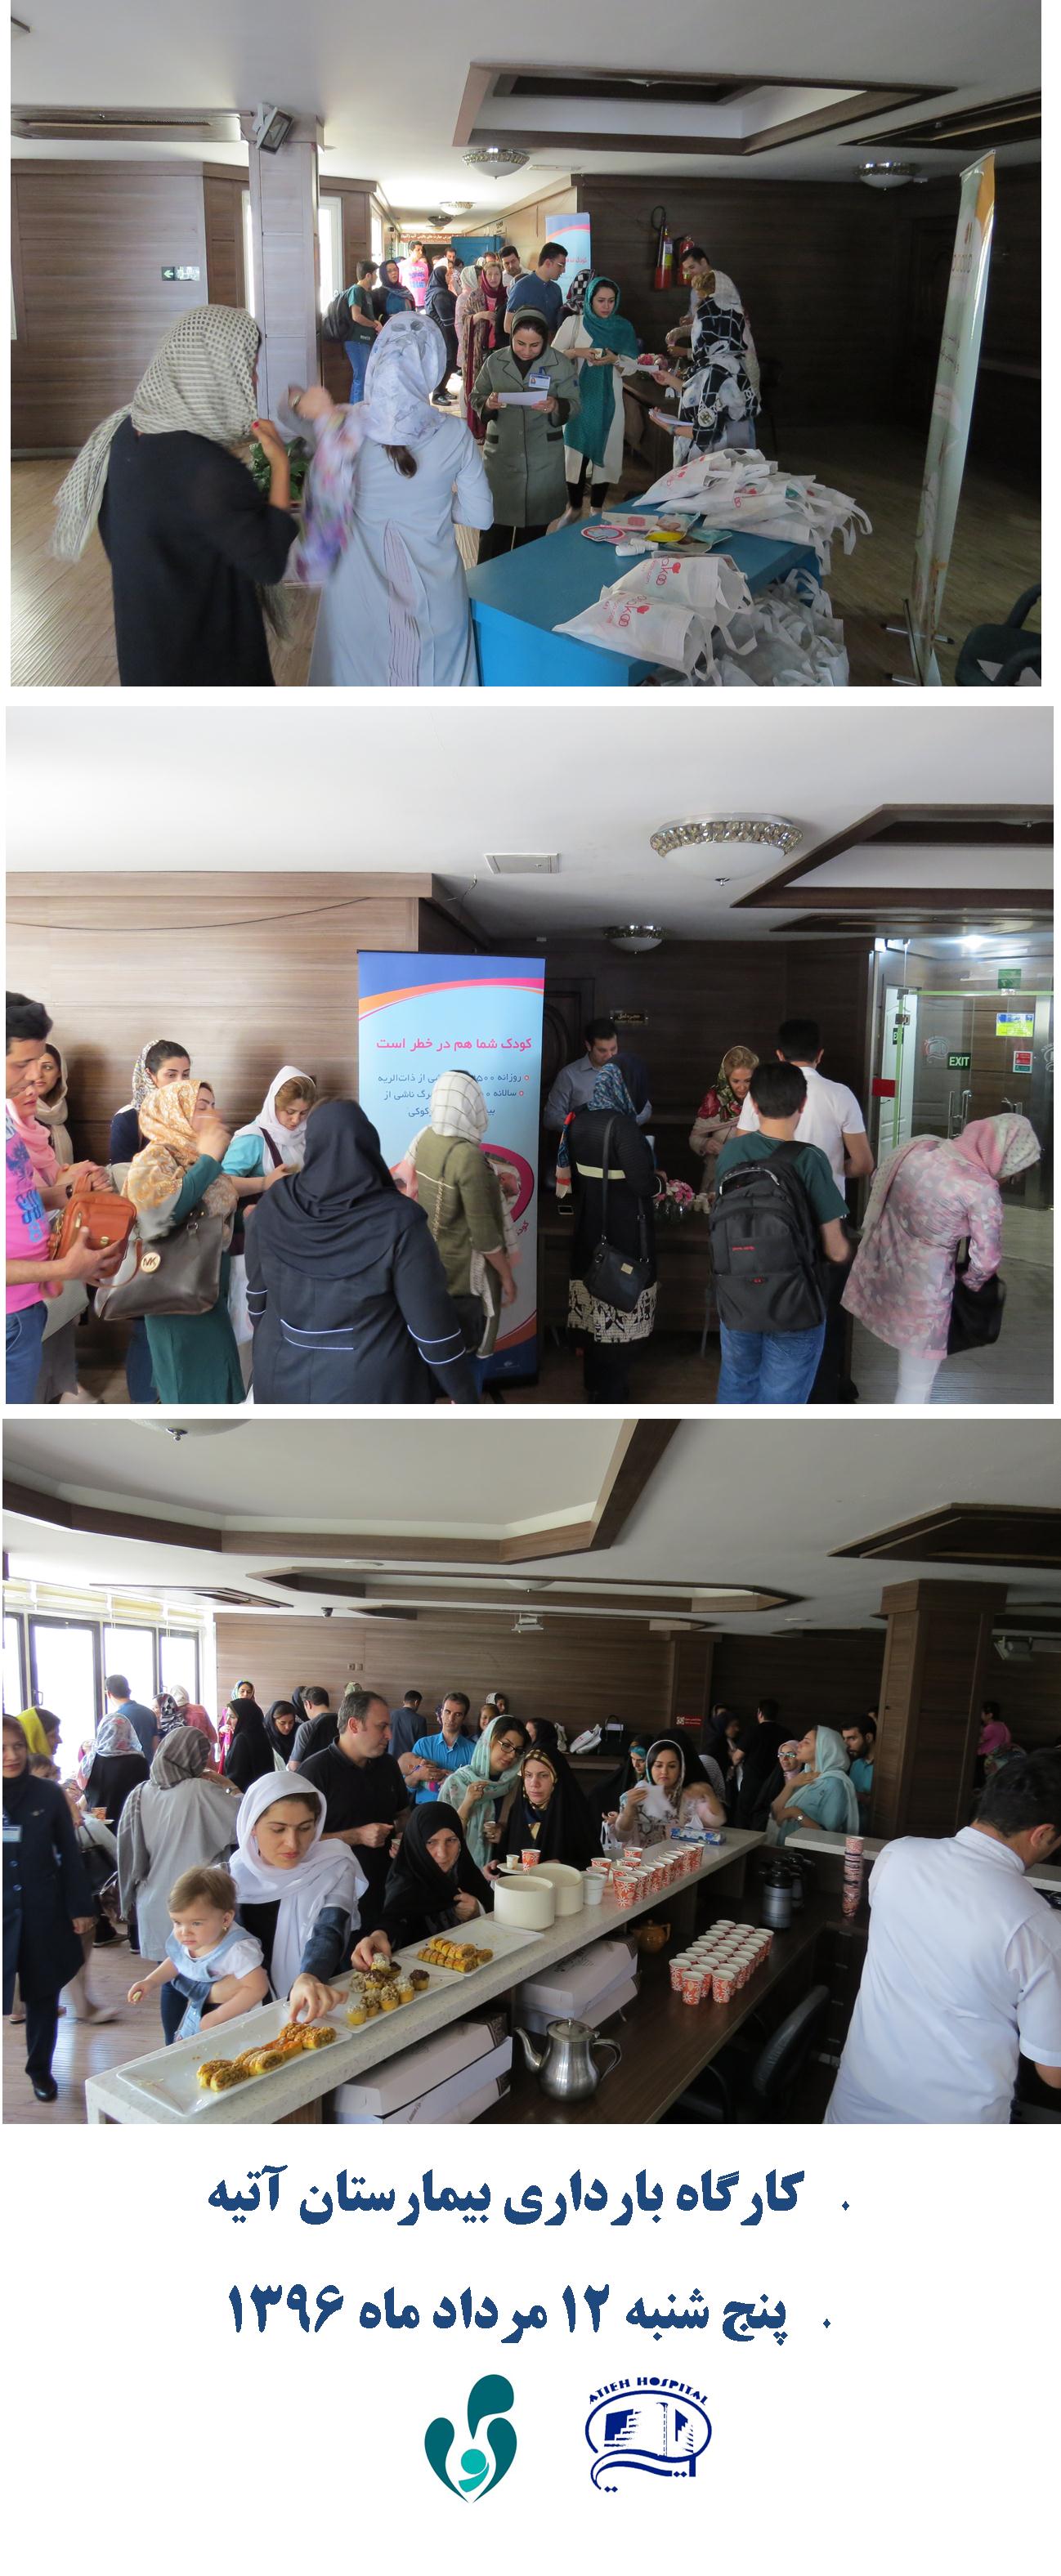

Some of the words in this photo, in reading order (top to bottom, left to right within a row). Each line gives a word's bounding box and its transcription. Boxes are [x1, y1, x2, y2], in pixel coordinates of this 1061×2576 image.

[376, 1038, 405, 1049] است
[410, 1038, 433, 1052] خطر
[436, 1040, 450, 1052] در
[454, 1040, 472, 1052] هم
[476, 1038, 498, 1049] شما
[501, 1038, 532, 1052] کودک
[949, 1056, 970, 1067] EXIT
[497, 1073, 522, 1082] روزانه
[142, 1255, 157, 1268] MK
